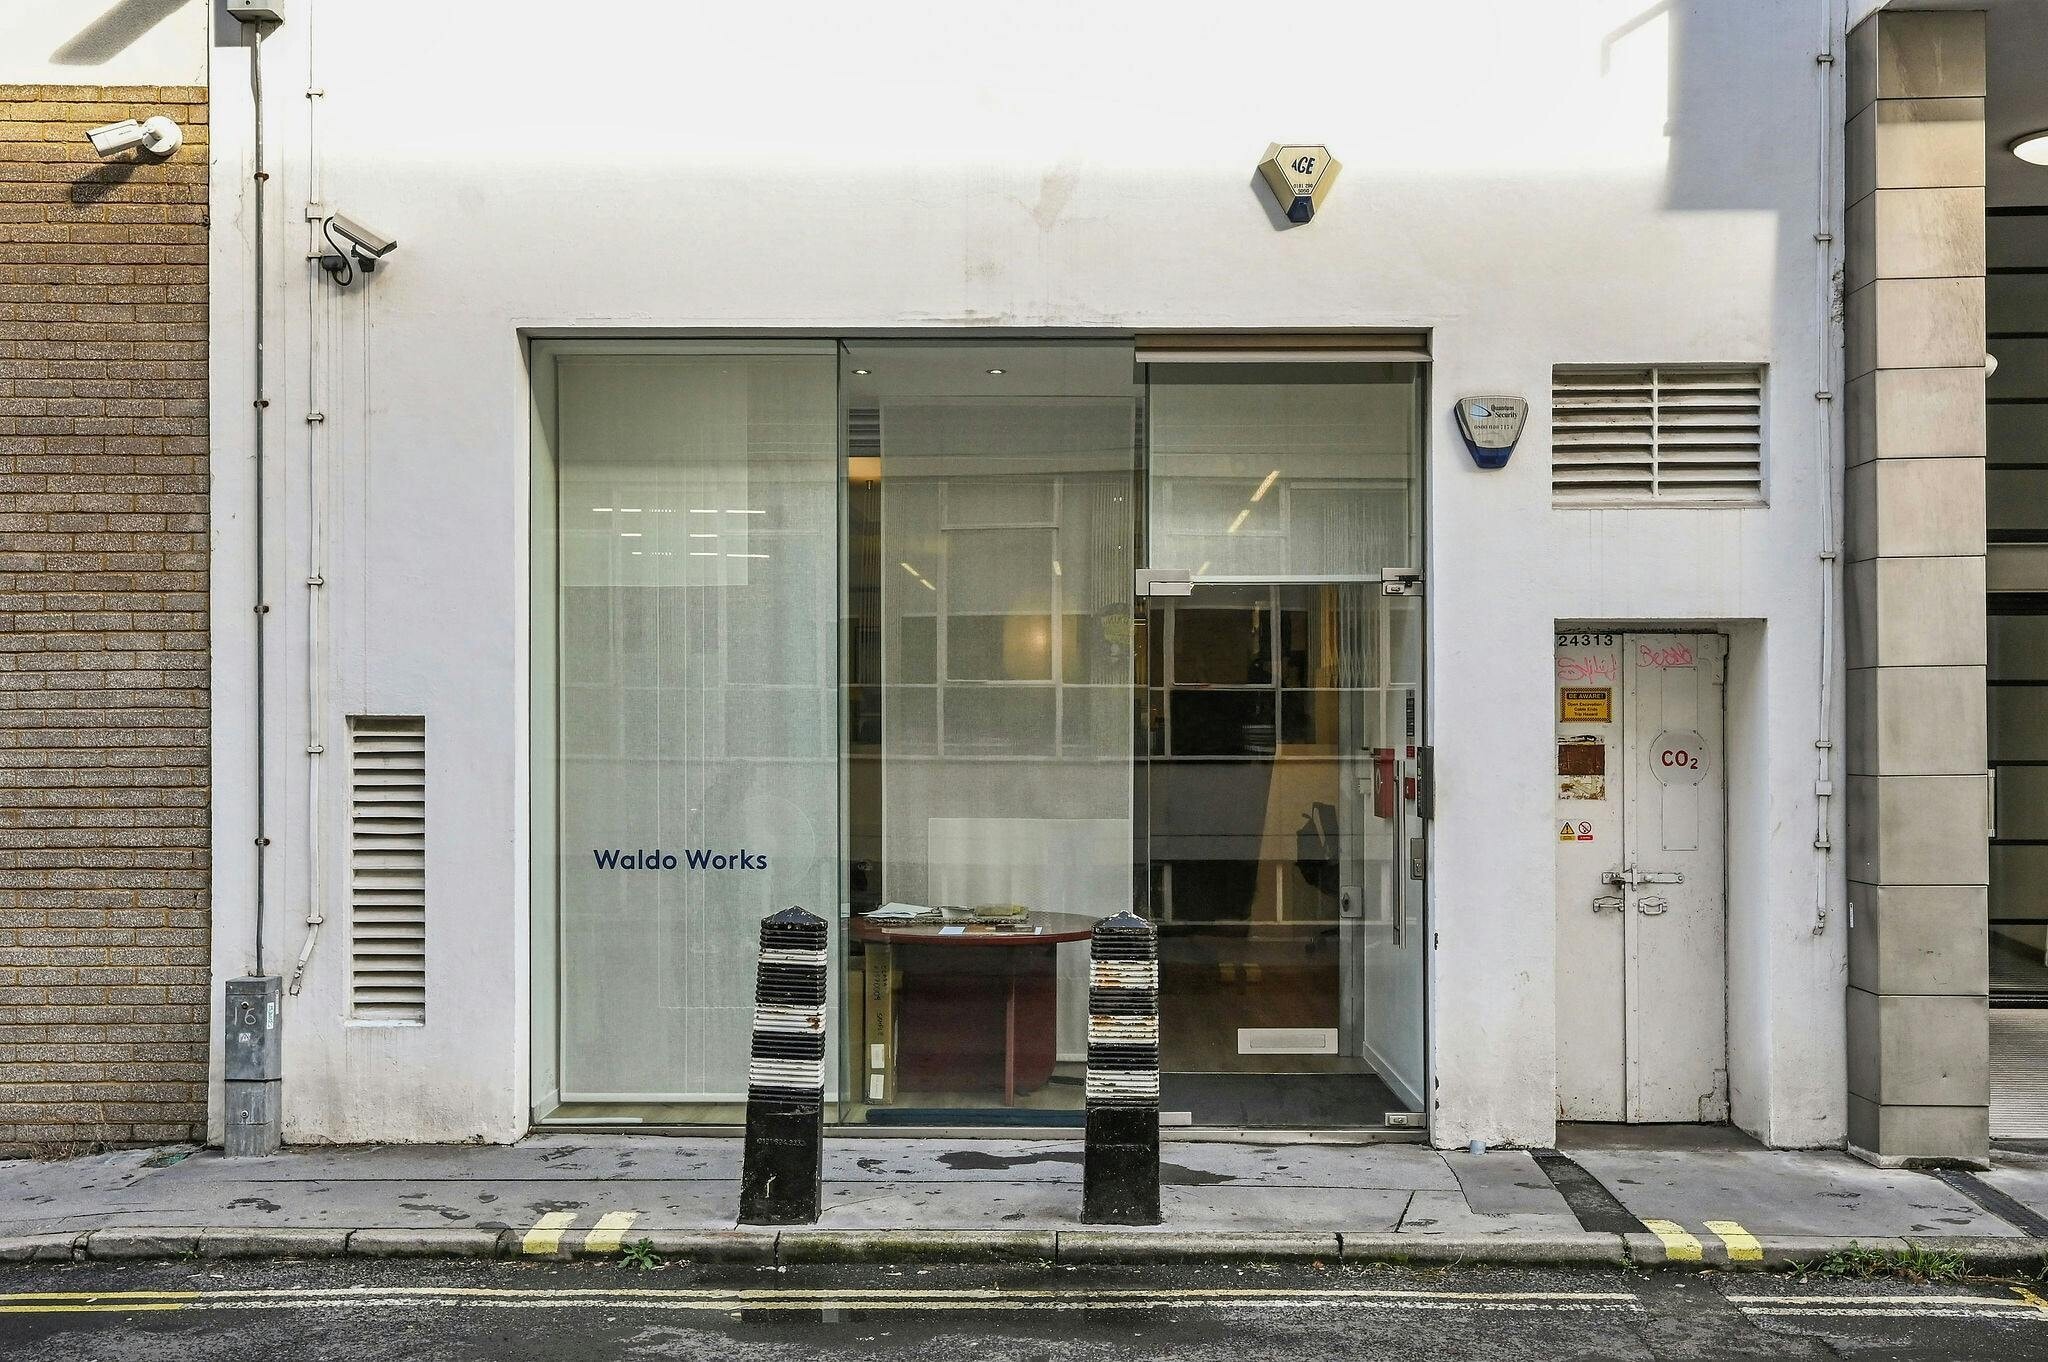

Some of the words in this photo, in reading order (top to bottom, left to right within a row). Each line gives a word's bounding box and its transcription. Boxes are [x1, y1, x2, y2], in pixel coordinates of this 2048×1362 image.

[1559, 635, 1613, 646] 24313
[593, 849, 677, 870] Waldo
[685, 849, 768, 870] Works
